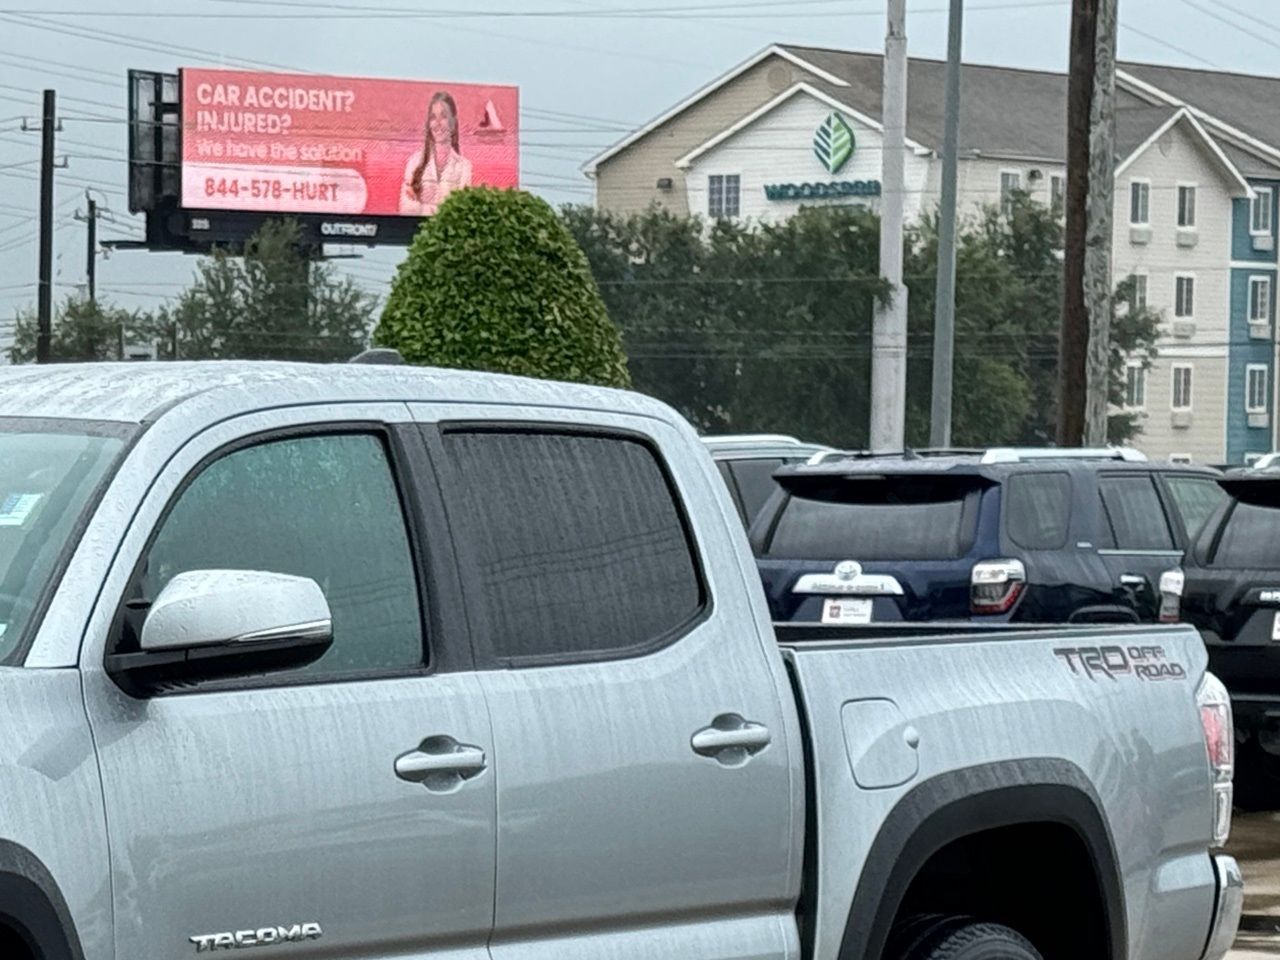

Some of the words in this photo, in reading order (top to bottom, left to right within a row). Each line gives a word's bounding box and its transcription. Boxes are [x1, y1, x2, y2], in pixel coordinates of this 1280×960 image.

[197, 83, 240, 106] CAR
[244, 86, 355, 112] ACCIDENT?
[197, 110, 292, 135] INJURED?
[227, 141, 267, 159] have
[271, 142, 297, 160] the
[205, 178, 340, 202] 844-578-HURT
[1053, 645, 1129, 682] TRD
[1133, 663, 1186, 681] ROAD
[189, 922, 322, 952] TACOMA
